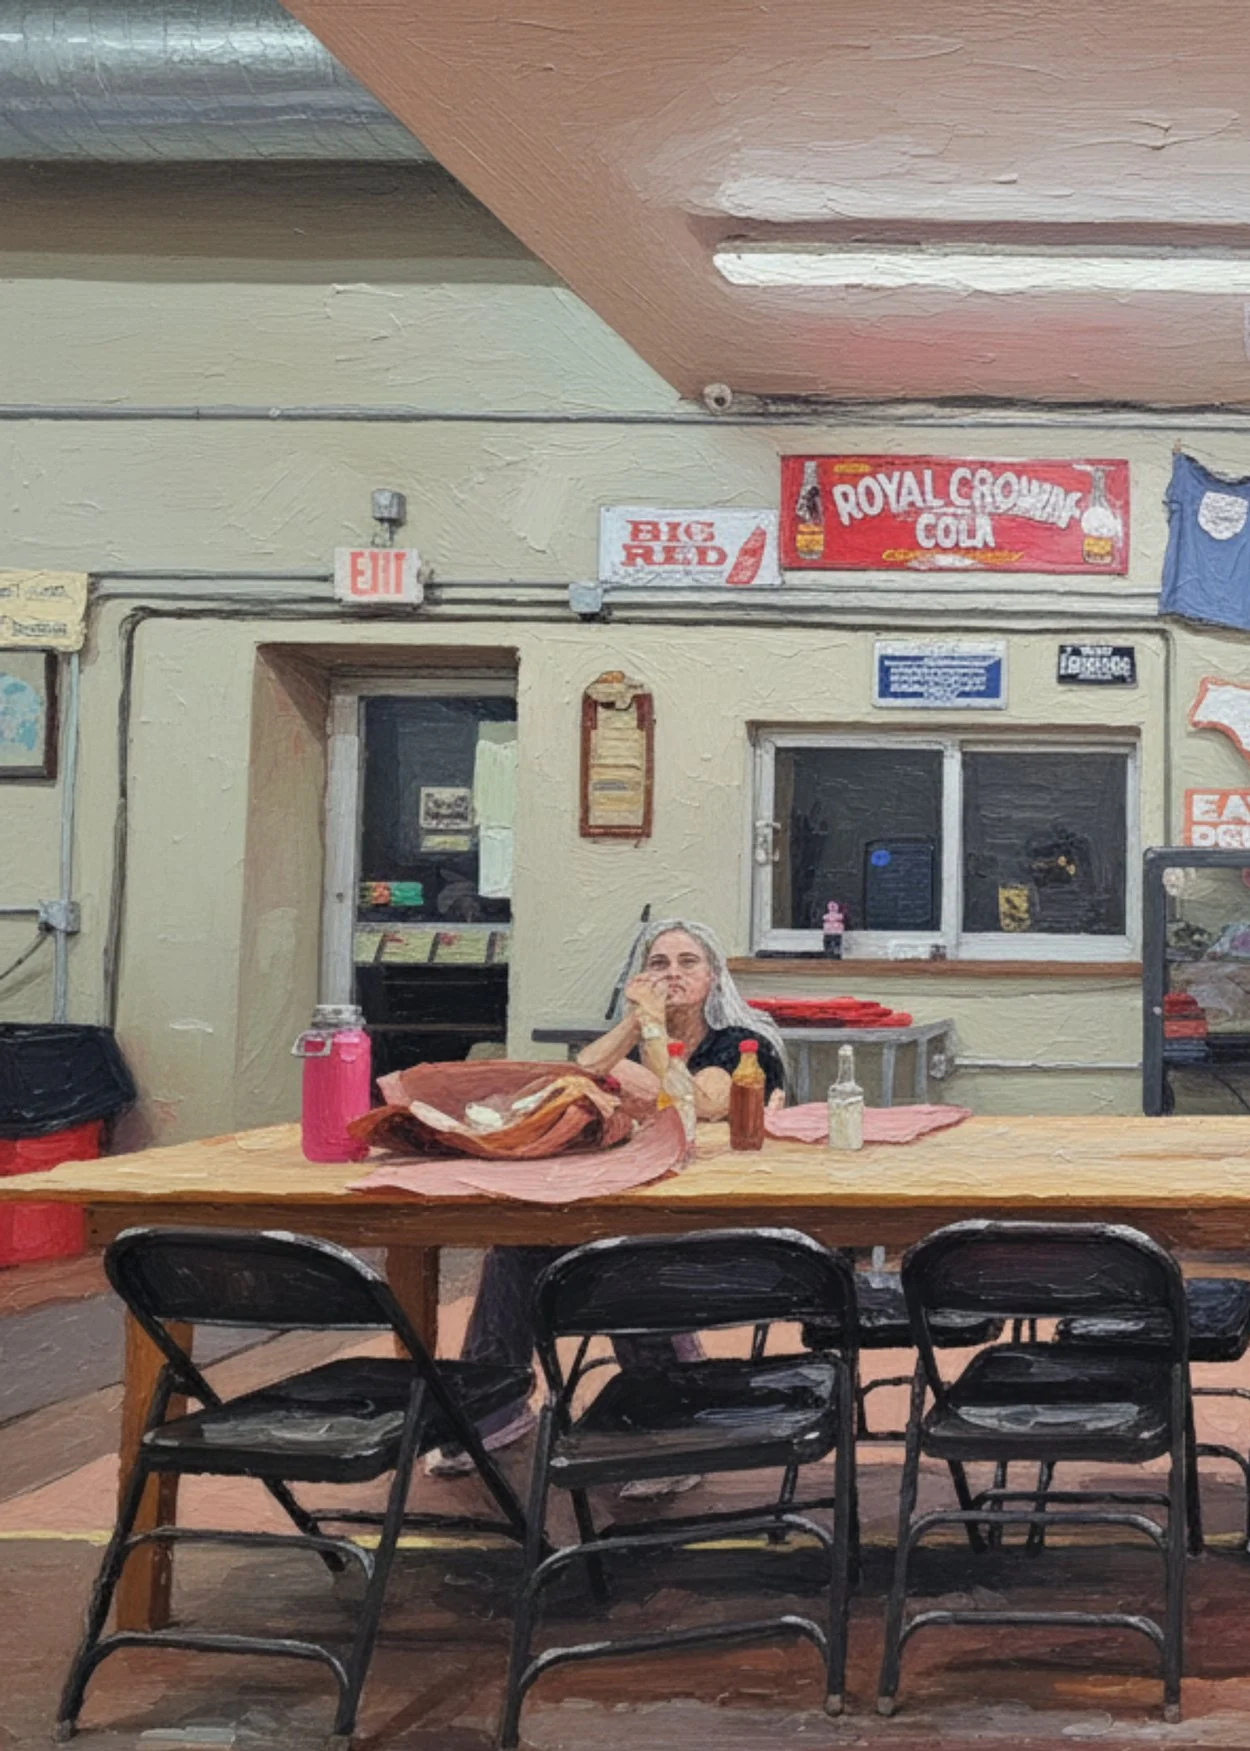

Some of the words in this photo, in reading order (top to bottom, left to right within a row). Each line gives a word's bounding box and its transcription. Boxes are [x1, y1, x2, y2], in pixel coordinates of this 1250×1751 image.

[832, 469, 945, 526] ROYAL
[626, 520, 715, 542] BIG
[915, 513, 995, 548] COLA
[621, 544, 728, 567] RED
[350, 551, 407, 596] EIT
